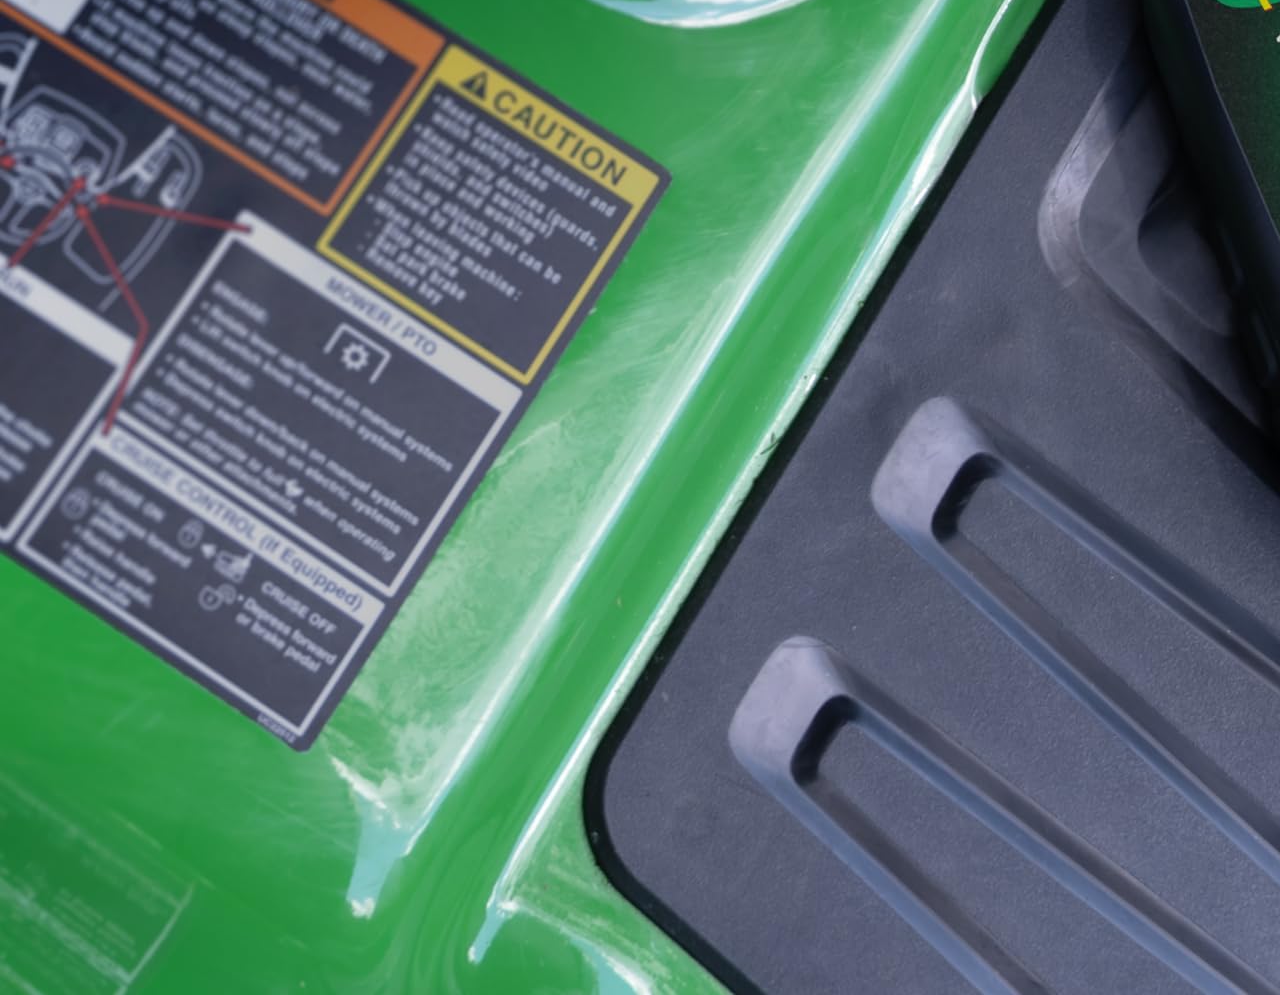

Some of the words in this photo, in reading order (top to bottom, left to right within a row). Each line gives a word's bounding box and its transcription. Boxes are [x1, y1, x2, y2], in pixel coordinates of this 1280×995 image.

[489, 86, 628, 187] CAUTION
[495, 175, 546, 213] devices
[511, 163, 549, 192] video
[540, 162, 590, 200] manual
[589, 194, 616, 217] and
[481, 203, 536, 245] working
[517, 251, 543, 272] can
[542, 265, 563, 284] be
[324, 277, 392, 327] MOWER
[399, 325, 439, 358] PTO
[354, 424, 409, 464] systems
[359, 405, 405, 440] manual
[402, 434, 454, 473] systems
[324, 458, 371, 494] manual
[367, 488, 420, 527] systems
[348, 496, 403, 537] systems
[174, 477, 260, 540] CONTROL
[276, 547, 365, 612] Equipped)
[334, 517, 396, 563] operating
[259, 580, 310, 619] CRUISE
[307, 611, 337, 637] OFF
[235, 613, 250, 627] or
[250, 622, 286, 650] brake
[283, 644, 321, 675] pedal
